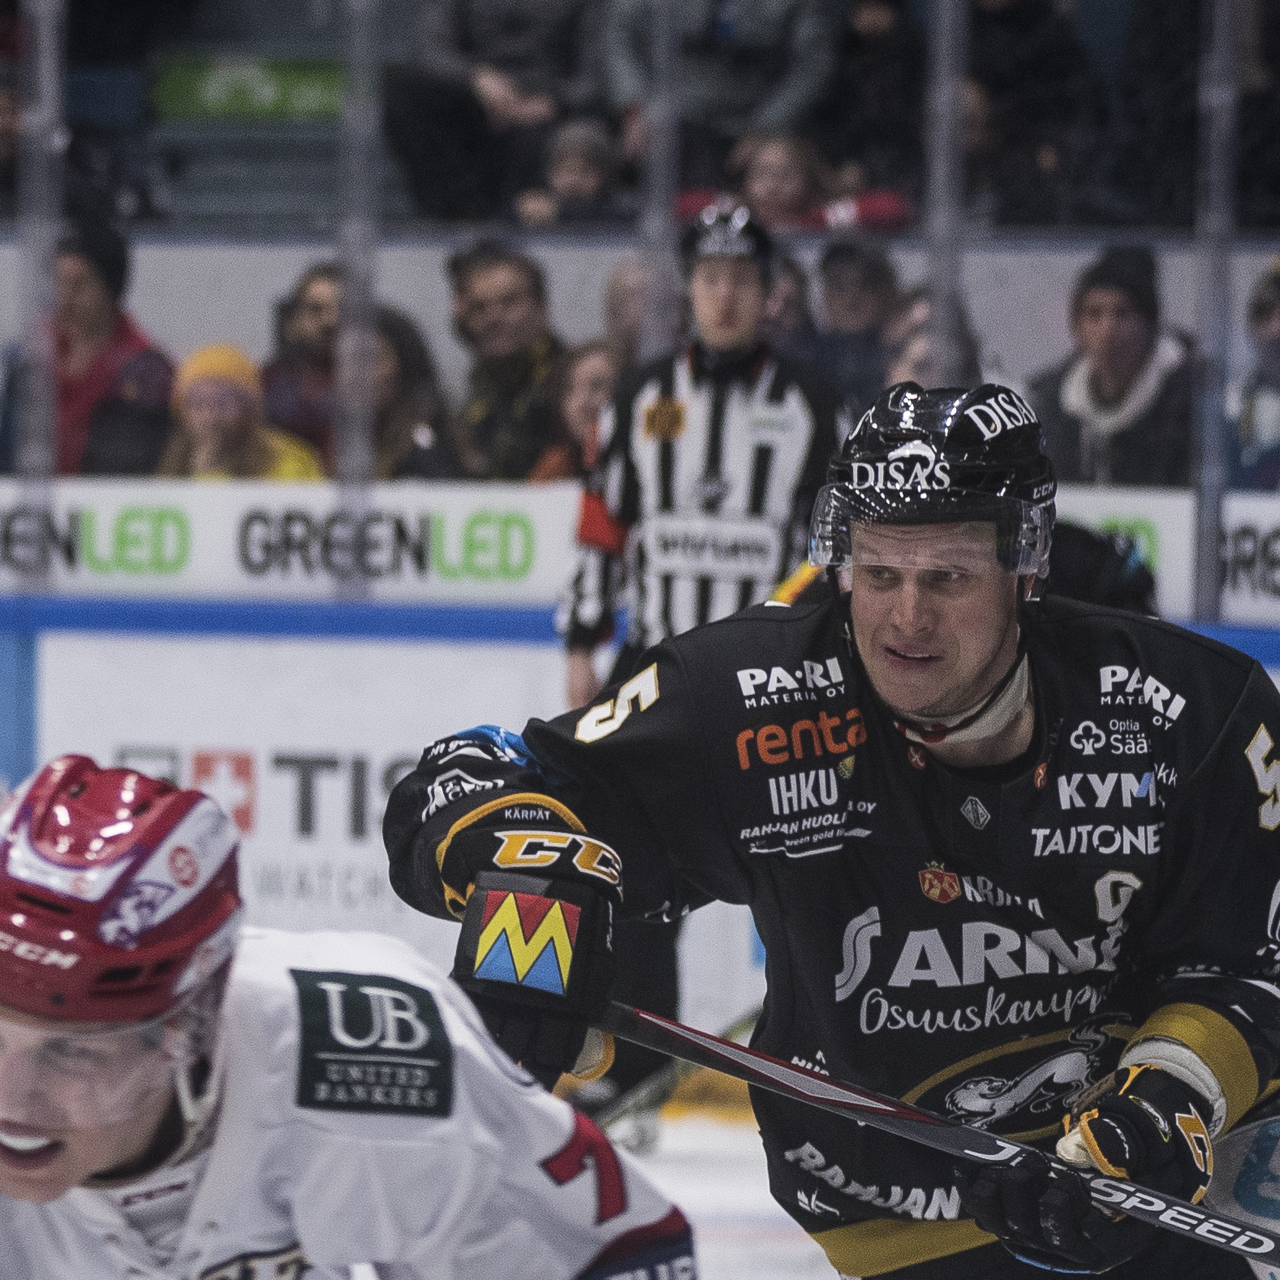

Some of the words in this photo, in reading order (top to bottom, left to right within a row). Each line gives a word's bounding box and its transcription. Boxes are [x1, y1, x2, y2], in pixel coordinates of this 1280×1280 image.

[851, 461, 951, 491] DISAS
[238, 509, 535, 581] GREENLED
[575, 662, 658, 745] 5
[826, 684, 846, 699] OY
[735, 707, 868, 771] renta
[504, 807, 551, 822] KÄRPÄT
[768, 768, 839, 815] IHKU
[317, 976, 431, 1049] UB
[539, 1110, 630, 1227] 7
